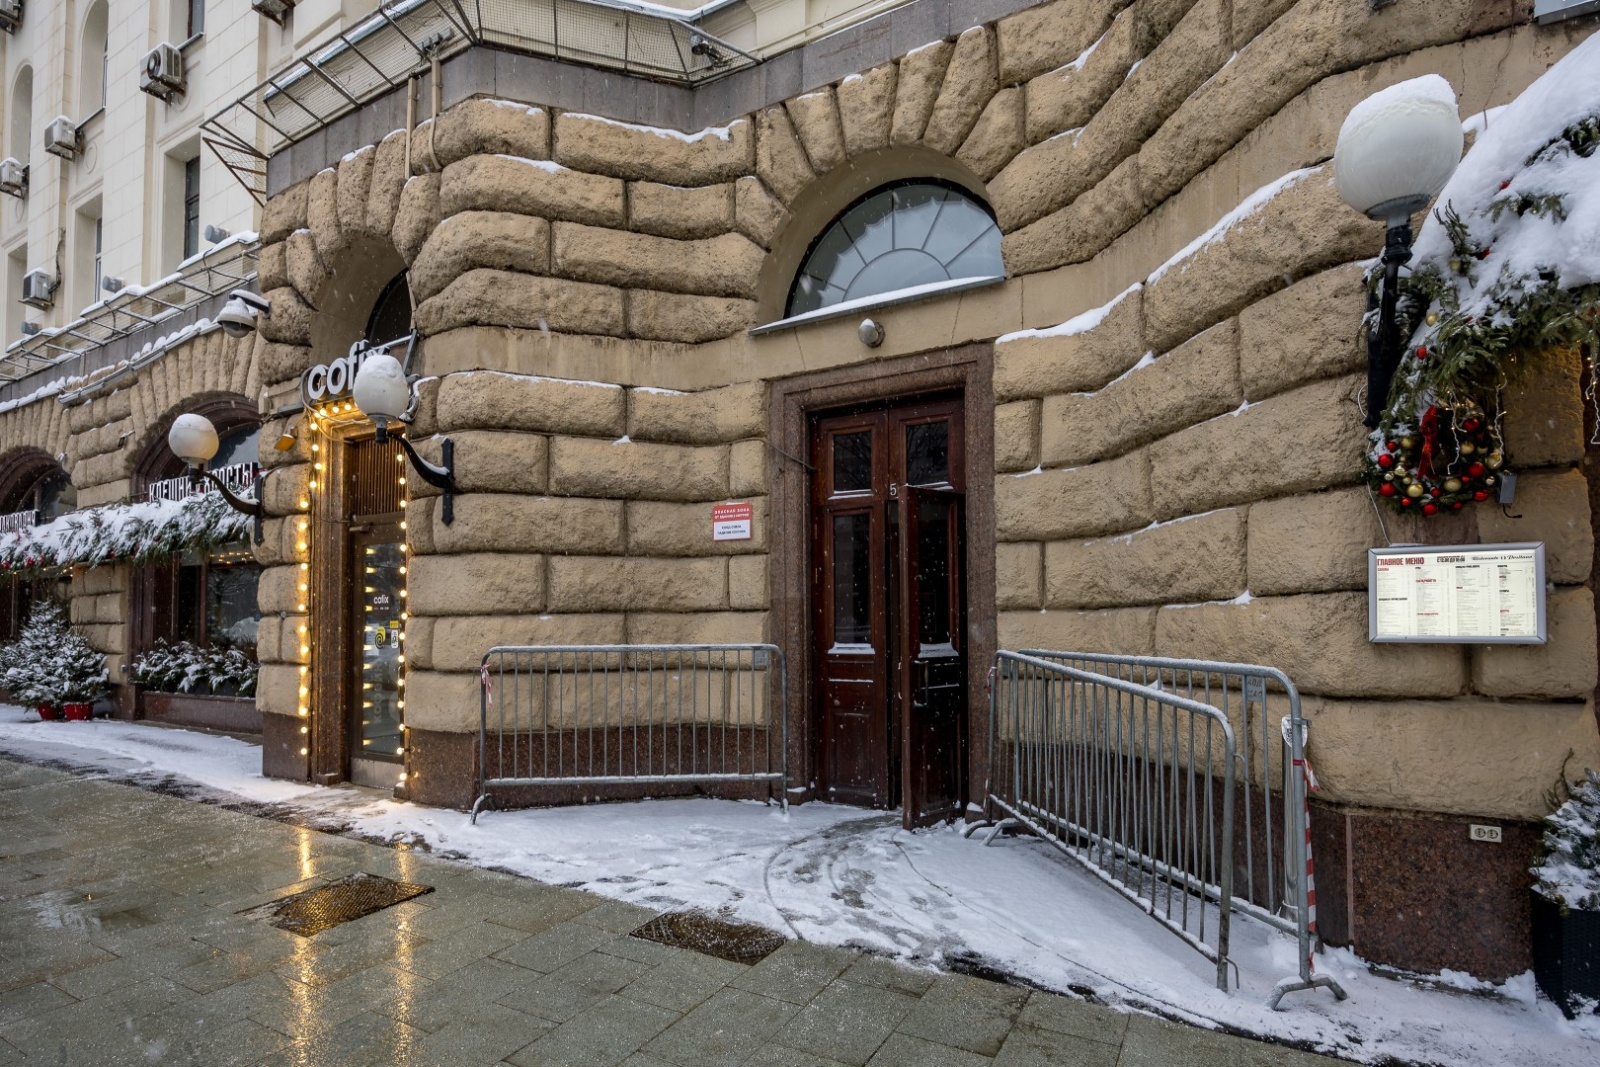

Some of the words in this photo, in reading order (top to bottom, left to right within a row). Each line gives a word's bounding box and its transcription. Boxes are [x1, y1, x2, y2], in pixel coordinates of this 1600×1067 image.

[890, 483, 897, 496] 5
[1377, 558, 1404, 566] ГЛАВНОЕ
[1405, 557, 1425, 565] МЕНЮ
[373, 594, 389, 604] cofix
